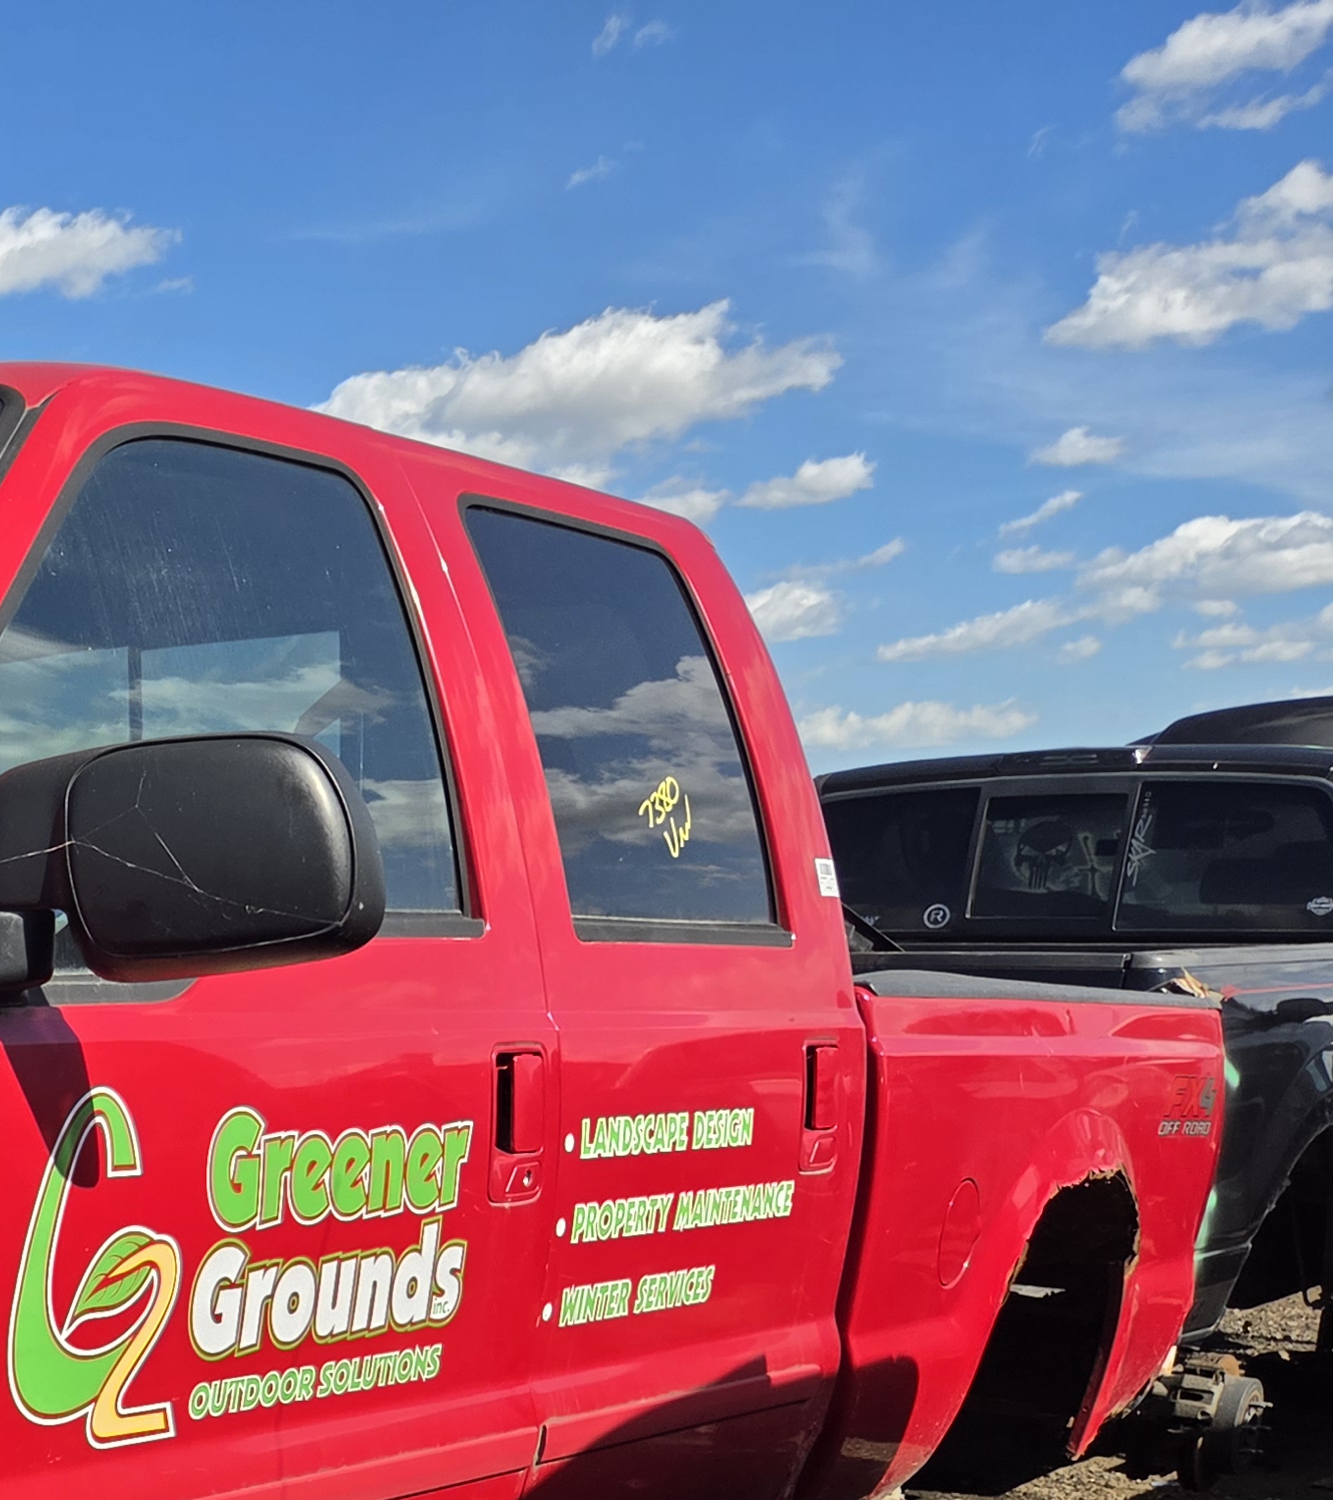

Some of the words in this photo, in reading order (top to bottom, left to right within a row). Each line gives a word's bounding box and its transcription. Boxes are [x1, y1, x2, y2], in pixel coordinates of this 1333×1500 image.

[638, 776, 680, 828] 7380
[1163, 1075, 1217, 1118] FX4
[580, 1112, 689, 1160] LANDSCAPE
[692, 1108, 755, 1150] DESIGN
[1158, 1121, 1181, 1136] OFF
[1181, 1121, 1212, 1136] ROAD
[206, 1105, 474, 1233] Greener
[570, 1193, 674, 1244] PROPERTY
[673, 1180, 795, 1231] MAINTENANCE
[188, 1215, 468, 1362] Grounds
[432, 1297, 450, 1315] inc.
[558, 1278, 631, 1328] WINTER
[633, 1264, 716, 1315] SERVICES
[188, 1365, 316, 1420] OUTDOOR
[317, 1344, 442, 1397] SOLUTIONS
